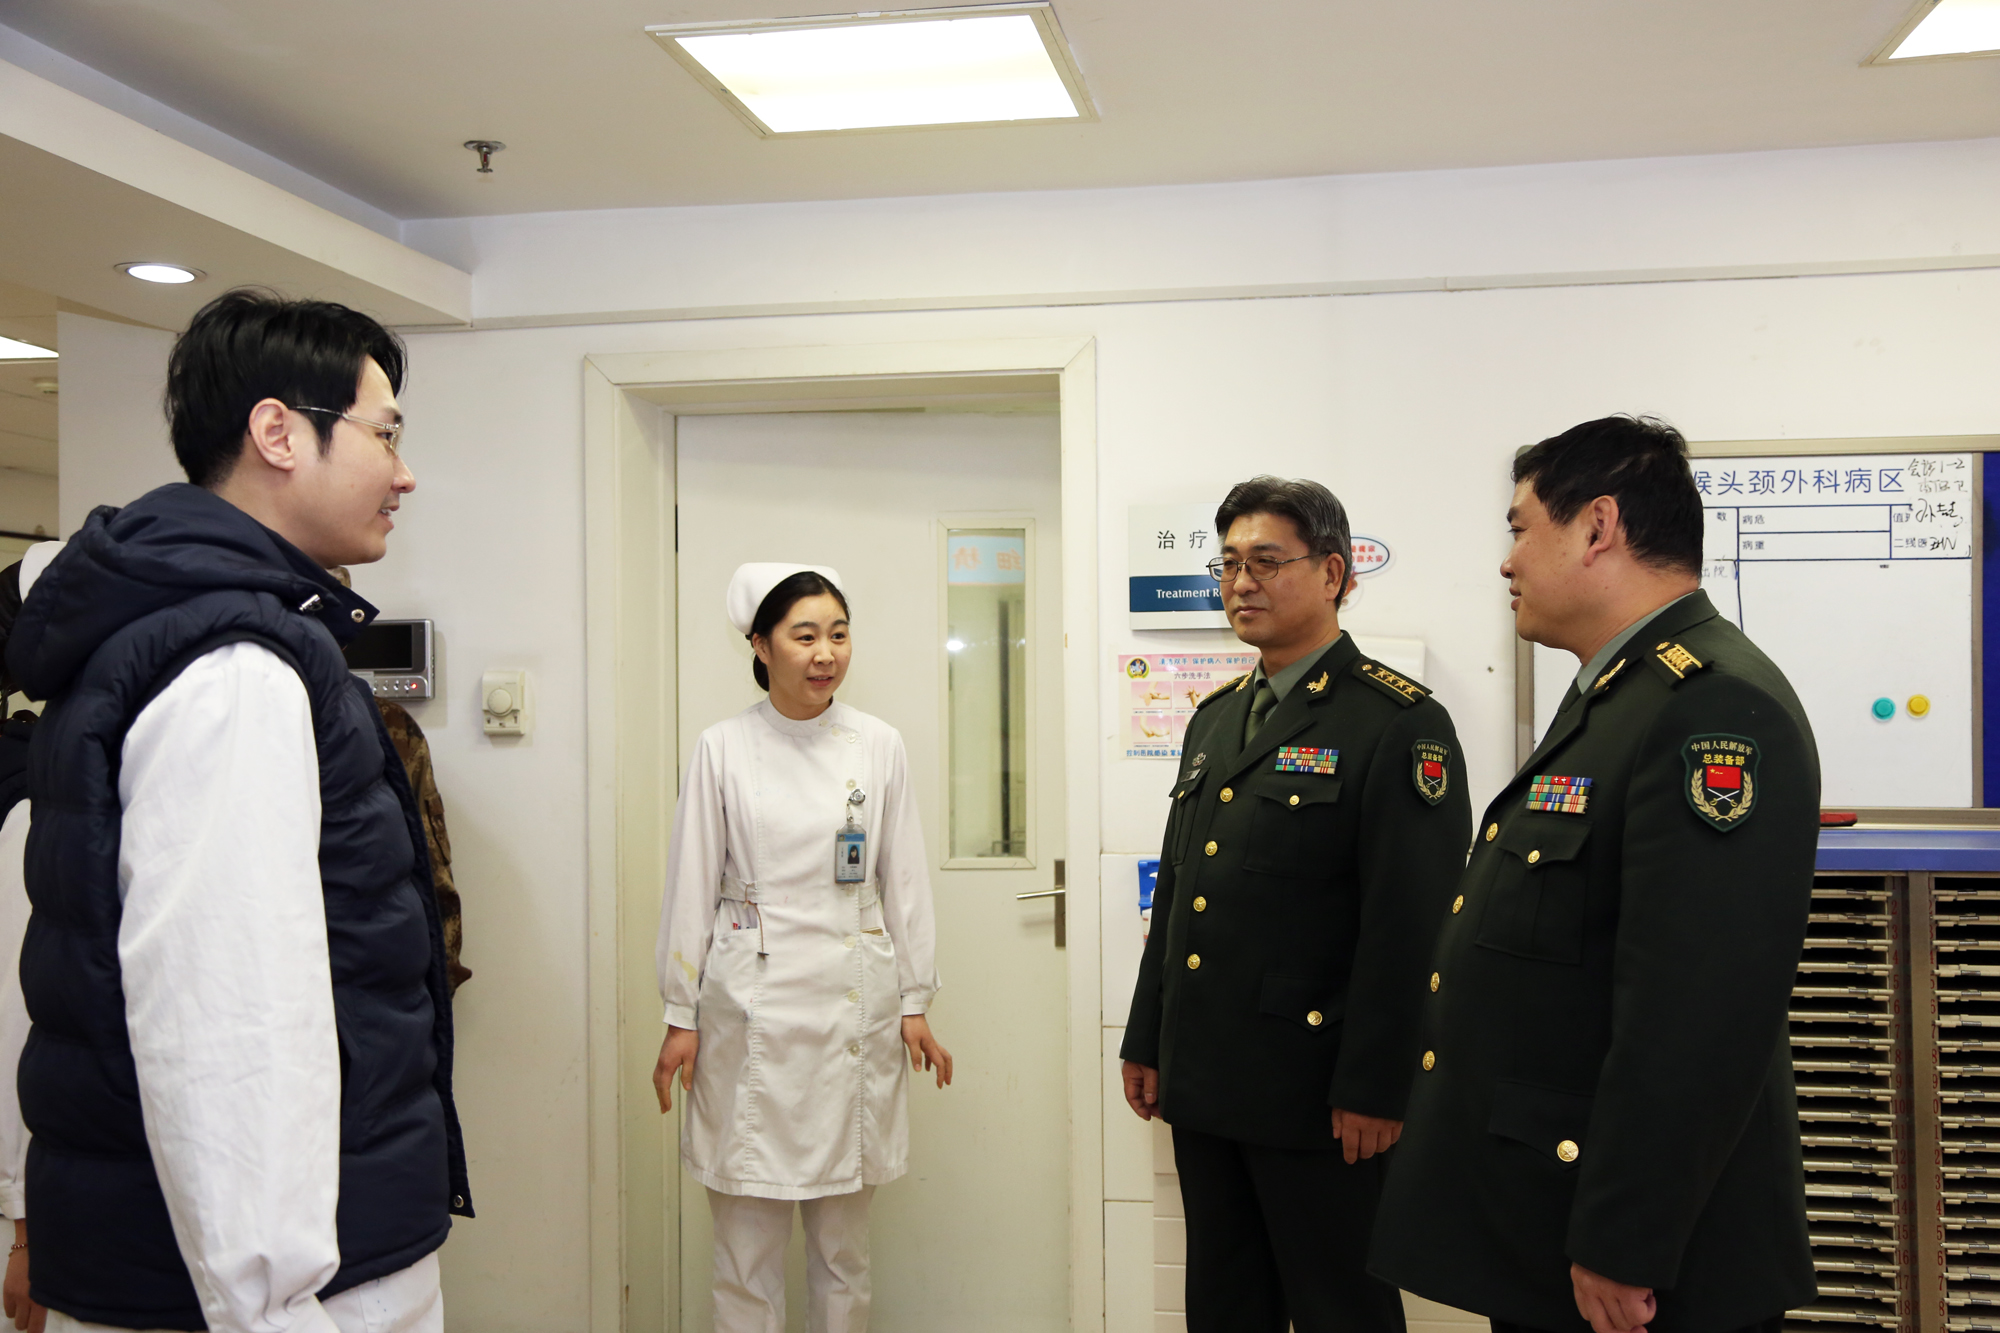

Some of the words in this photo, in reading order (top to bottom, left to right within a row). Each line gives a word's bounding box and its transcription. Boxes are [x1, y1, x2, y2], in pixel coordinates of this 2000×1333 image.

[1742, 514, 1765, 525] 病危
[1157, 529, 1208, 549] 治疗
[1742, 540, 1765, 550] 病重
[1156, 589, 1210, 598] Treatment
[1192, 657, 1222, 665] 保护病人
[1226, 656, 1255, 664] 保护自己
[1174, 672, 1211, 680] 六步洗手法
[1691, 740, 1753, 755] 中国人民解放军
[1702, 753, 1745, 766] 总装备部
